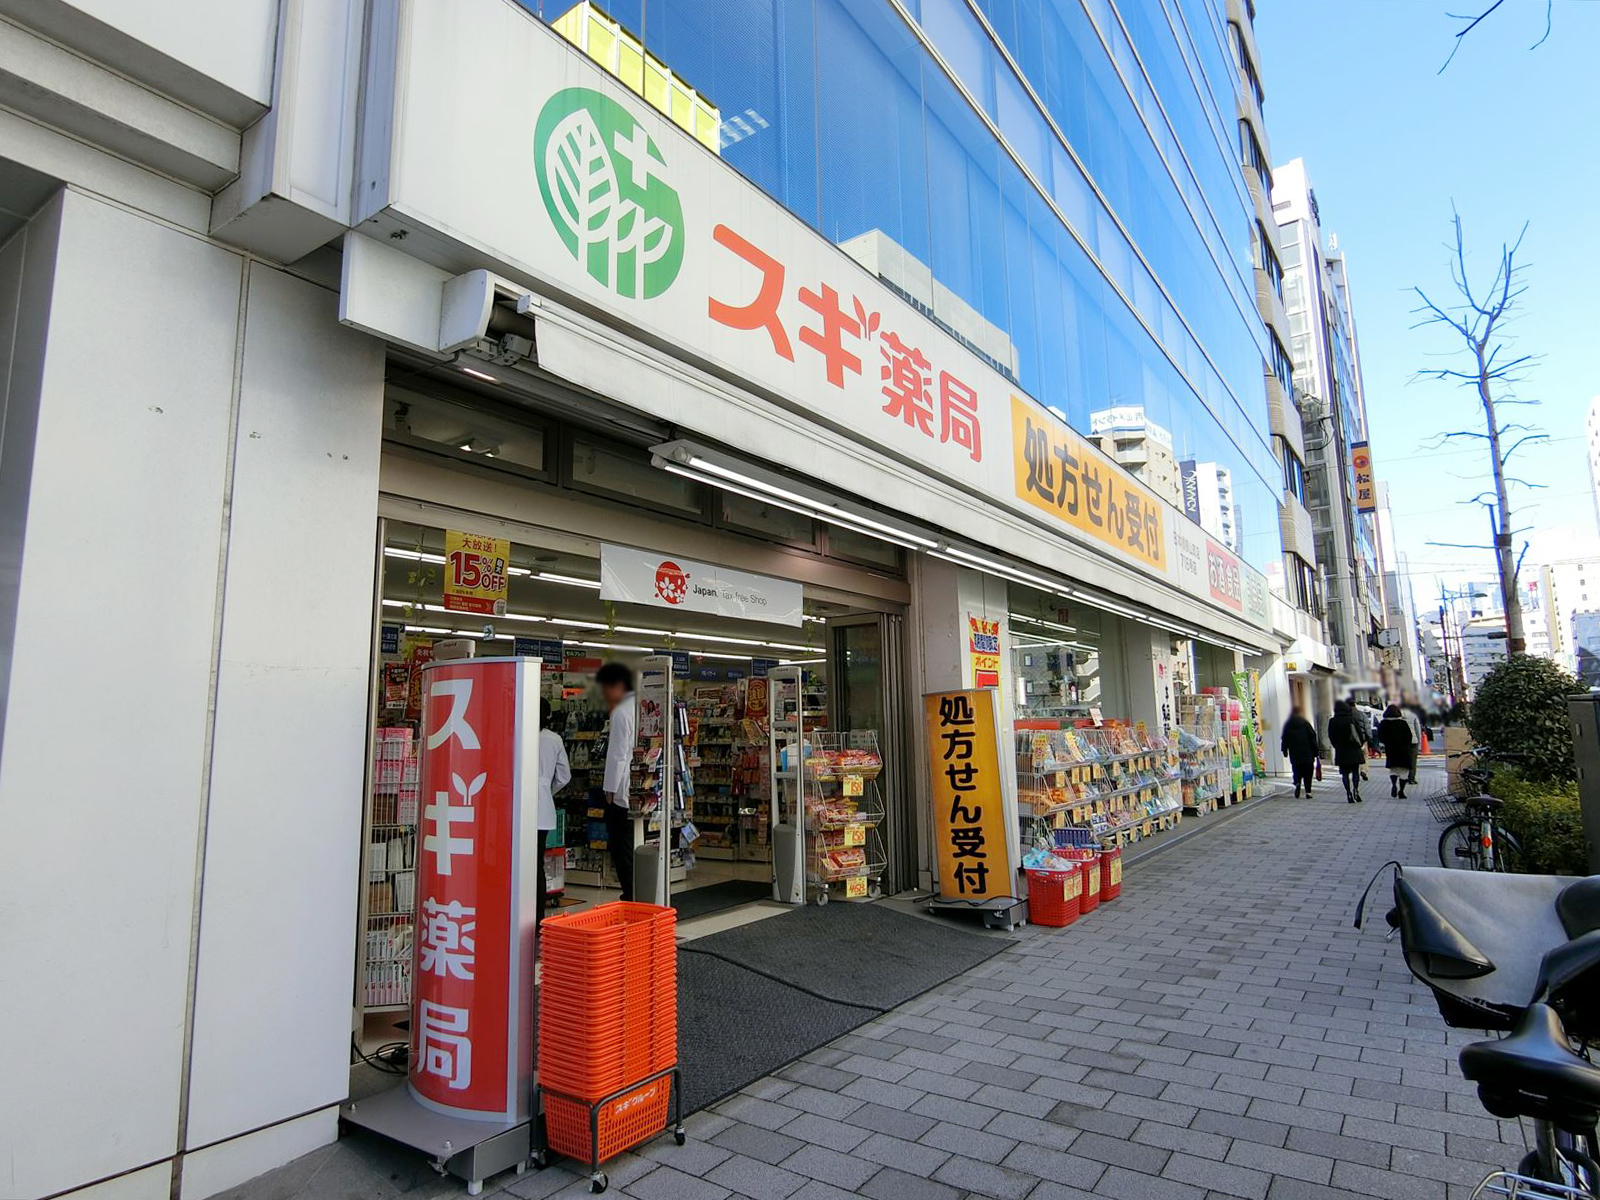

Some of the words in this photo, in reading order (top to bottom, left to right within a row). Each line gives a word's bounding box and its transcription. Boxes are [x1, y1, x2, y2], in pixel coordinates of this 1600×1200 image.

[708, 223, 982, 463] スギ薬局
[1024, 417, 1160, 562] 処方せん受付
[1356, 473, 1371, 501] 松屋
[481, 574, 506, 591] OFF
[750, 594, 767, 606] Shop
[939, 696, 989, 895] 処方せん受付
[417, 678, 486, 1091] スギ薬局
